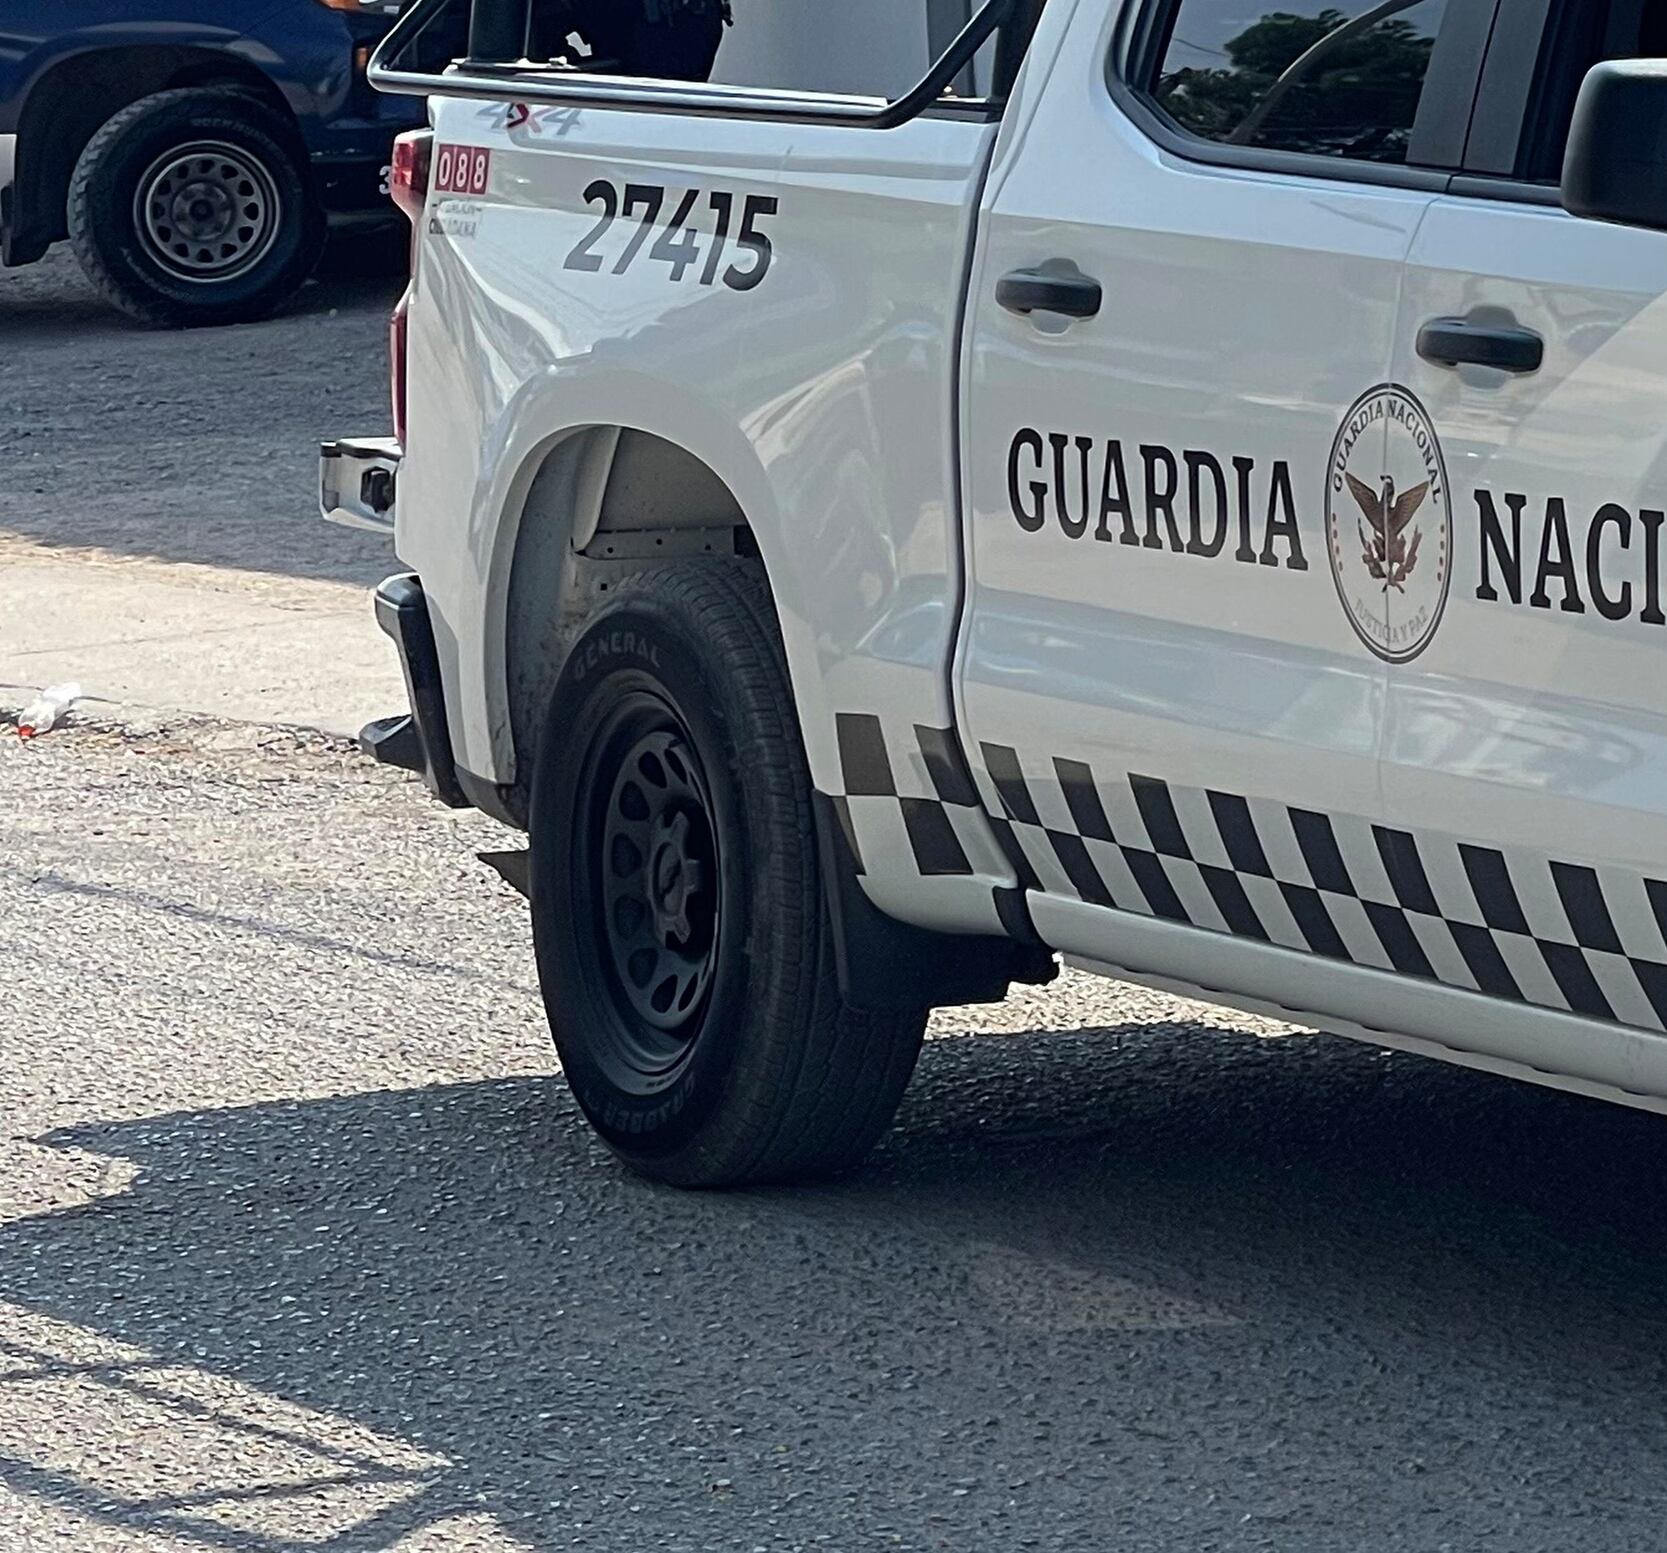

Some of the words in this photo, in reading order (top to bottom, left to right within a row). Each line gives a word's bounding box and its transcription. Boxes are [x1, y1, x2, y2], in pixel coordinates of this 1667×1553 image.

[438, 150, 486, 190] 088
[563, 179, 779, 292] 27415
[1007, 426, 1310, 573] GUARDIA
[1332, 398, 1384, 494] GUARDIA
[1387, 398, 1442, 505] NACIONAL
[575, 630, 661, 681] GENERAL
